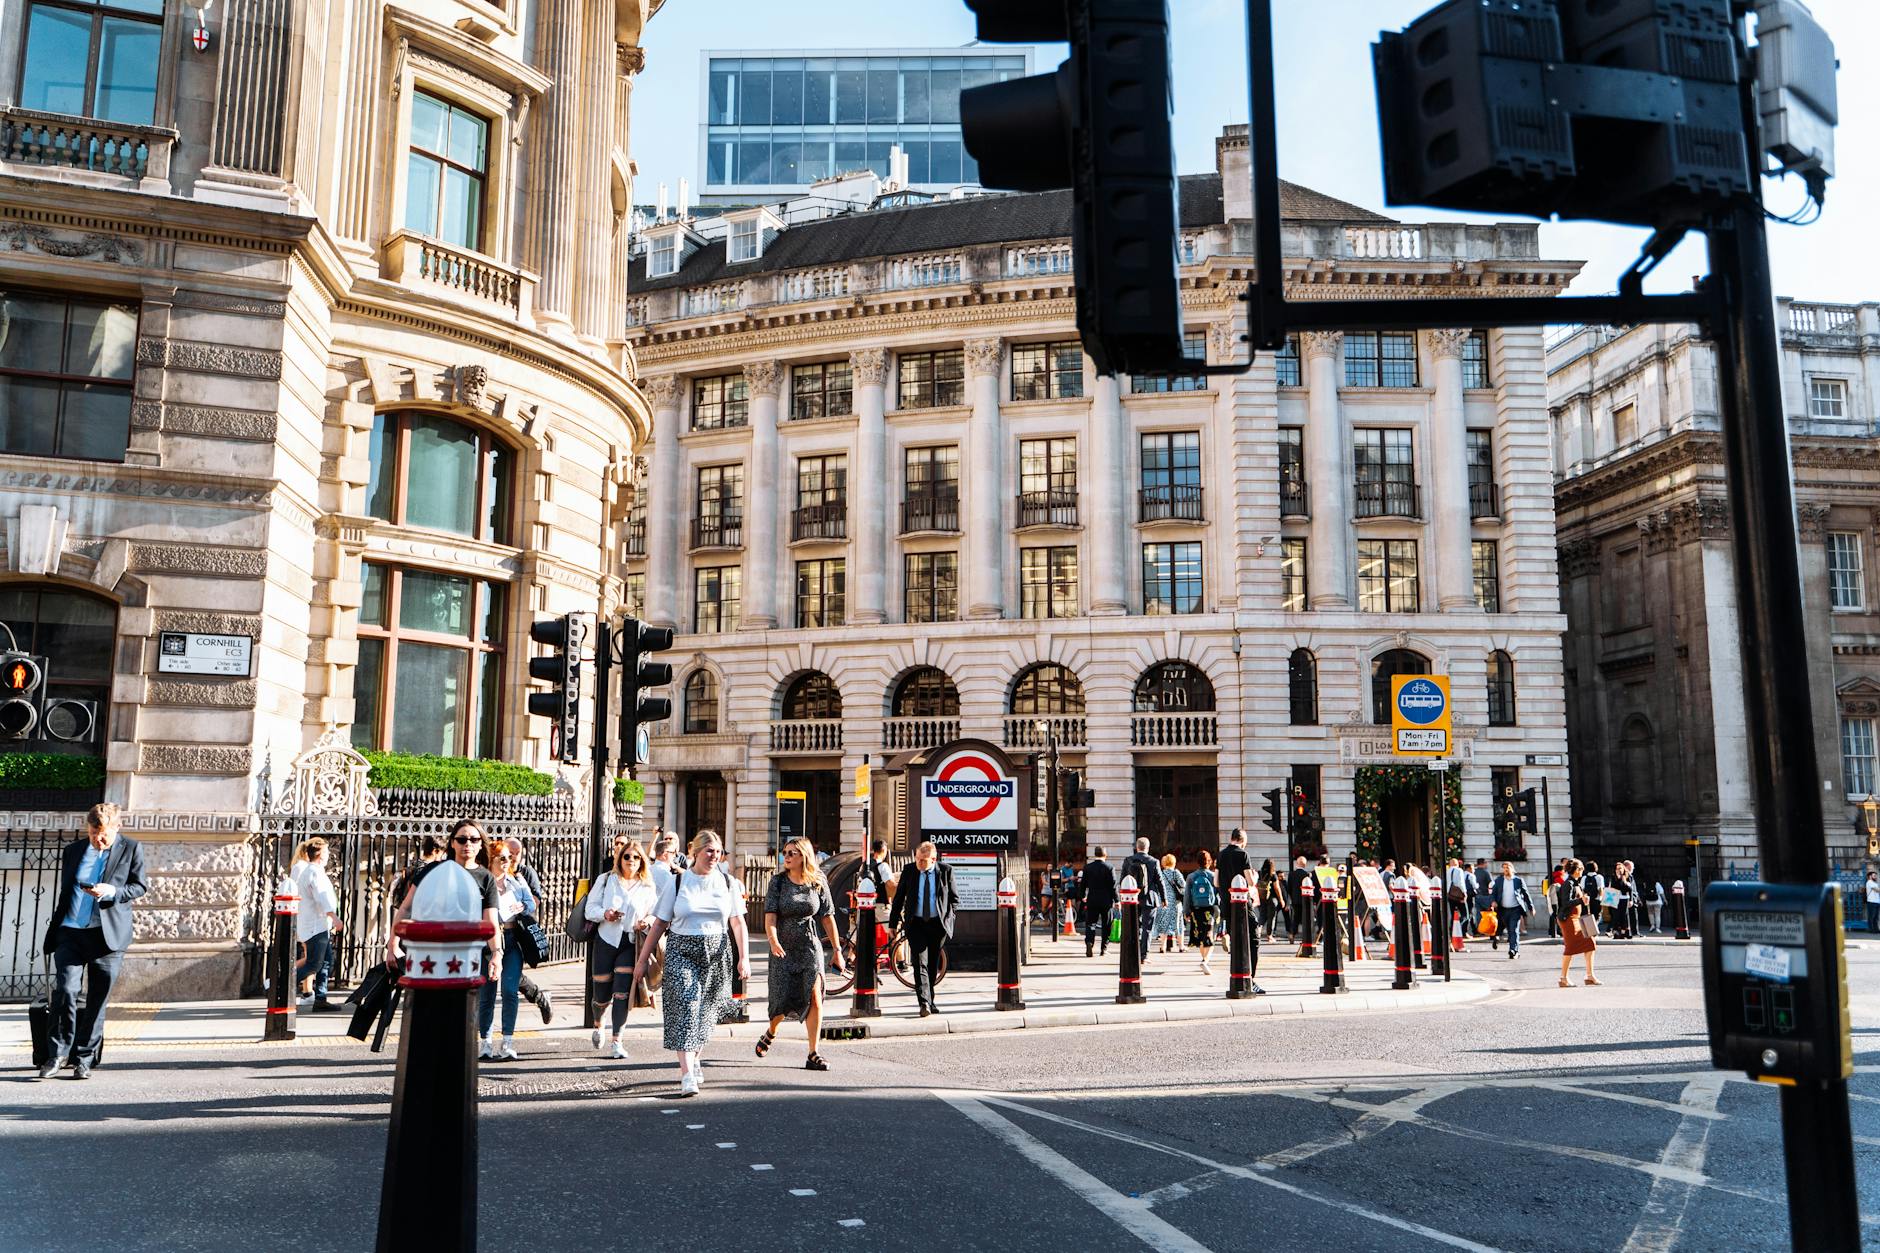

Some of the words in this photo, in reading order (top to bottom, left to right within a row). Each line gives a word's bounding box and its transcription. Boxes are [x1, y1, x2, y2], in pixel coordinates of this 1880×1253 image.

[196, 638, 243, 648] CORNHILL
[225, 649, 242, 657] EC3
[930, 835, 960, 845] BANK
[965, 835, 1009, 845] STATION
[1724, 913, 1801, 924] PEDESTRIANS
[1724, 924, 1742, 932] push
[1744, 924, 1768, 932] button
[1742, 932, 1763, 940] signal
